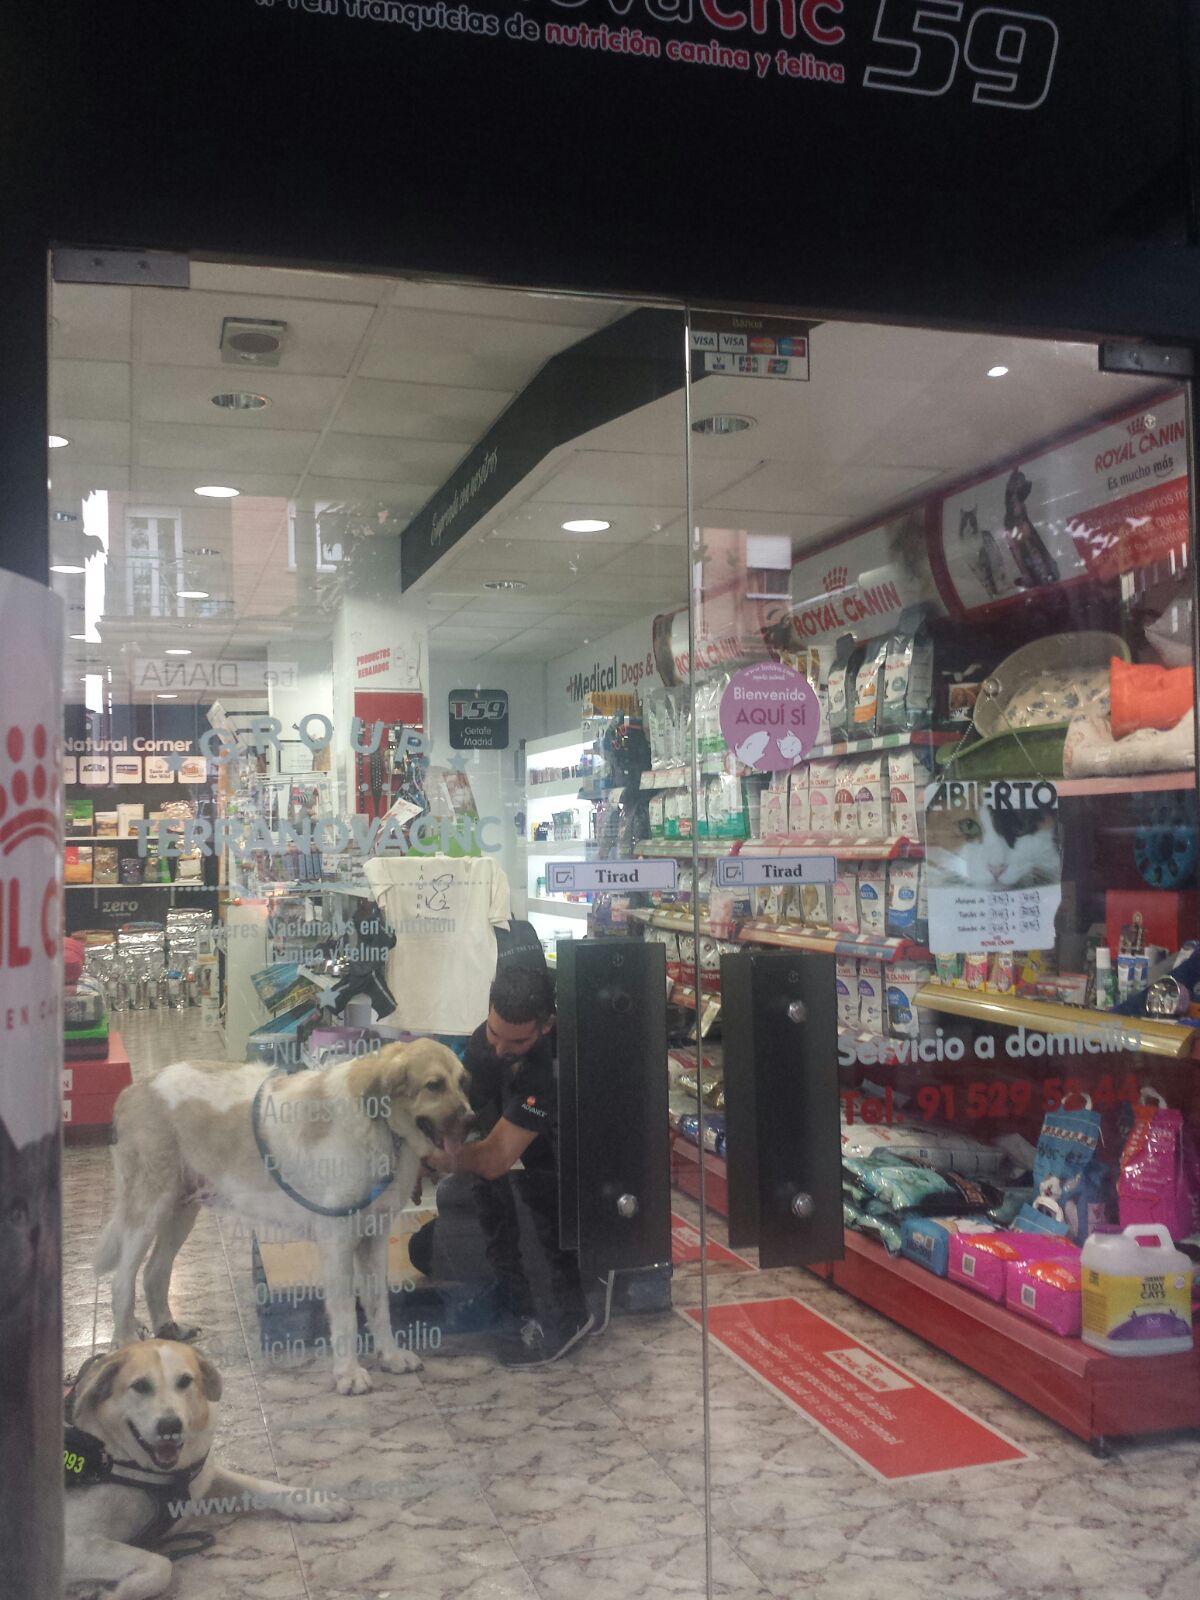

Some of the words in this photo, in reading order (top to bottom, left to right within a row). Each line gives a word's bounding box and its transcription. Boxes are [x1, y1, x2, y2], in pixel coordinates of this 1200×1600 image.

[504, 12, 540, 41] de
[545, 23, 661, 57] nutrición
[666, 39, 749, 69] canina
[755, 51, 771, 78] y
[776, 49, 845, 83] felina
[863, 0, 1059, 110] 59
[694, 336, 715, 346] VISA
[723, 337, 744, 346] VISA
[1094, 442, 1136, 473] ROYAL
[1138, 420, 1185, 455] CANIN
[1107, 476, 1119, 491] Es
[1119, 464, 1151, 486] mucho
[1152, 454, 1174, 474] más
[792, 603, 845, 639] ROYAL
[846, 580, 903, 625] CANIN
[356, 648, 391, 667] PRODUCTOS
[675, 648, 709, 677] ROAL
[707, 636, 745, 666] CANIN
[573, 655, 618, 702] Medical
[621, 662, 644, 686] Dogs
[733, 687, 807, 701] Bienvenido
[735, 703, 785, 726] AQUÍ
[790, 703, 806, 726] SÍ
[198, 713, 433, 766] GROUP
[463, 737, 493, 746] Madrid
[464, 726, 493, 736] Getafe
[64, 737, 128, 752] Natural
[133, 737, 193, 752] Corner
[927, 782, 1058, 811] ABIERTO
[128, 814, 504, 859] TERRANOVACNC
[595, 868, 640, 884] Tirad
[762, 863, 803, 878] Tirad
[102, 900, 139, 913] zero
[360, 919, 379, 937] en
[345, 943, 390, 963] felina
[838, 1028, 966, 1065] Servicio
[974, 1040, 996, 1059] a
[1005, 1018, 1143, 1059] domicilio
[521, 1103, 547, 1118] ADVANCE
[841, 1086, 904, 1126] Tel.
[917, 1084, 956, 1121] 91
[967, 1081, 1031, 1118] 529
[1141, 1291, 1166, 1300] CATS
[1142, 1283, 1165, 1292] TIDY
[314, 1336, 328, 1360] a
[333, 1321, 442, 1361] domcilio
